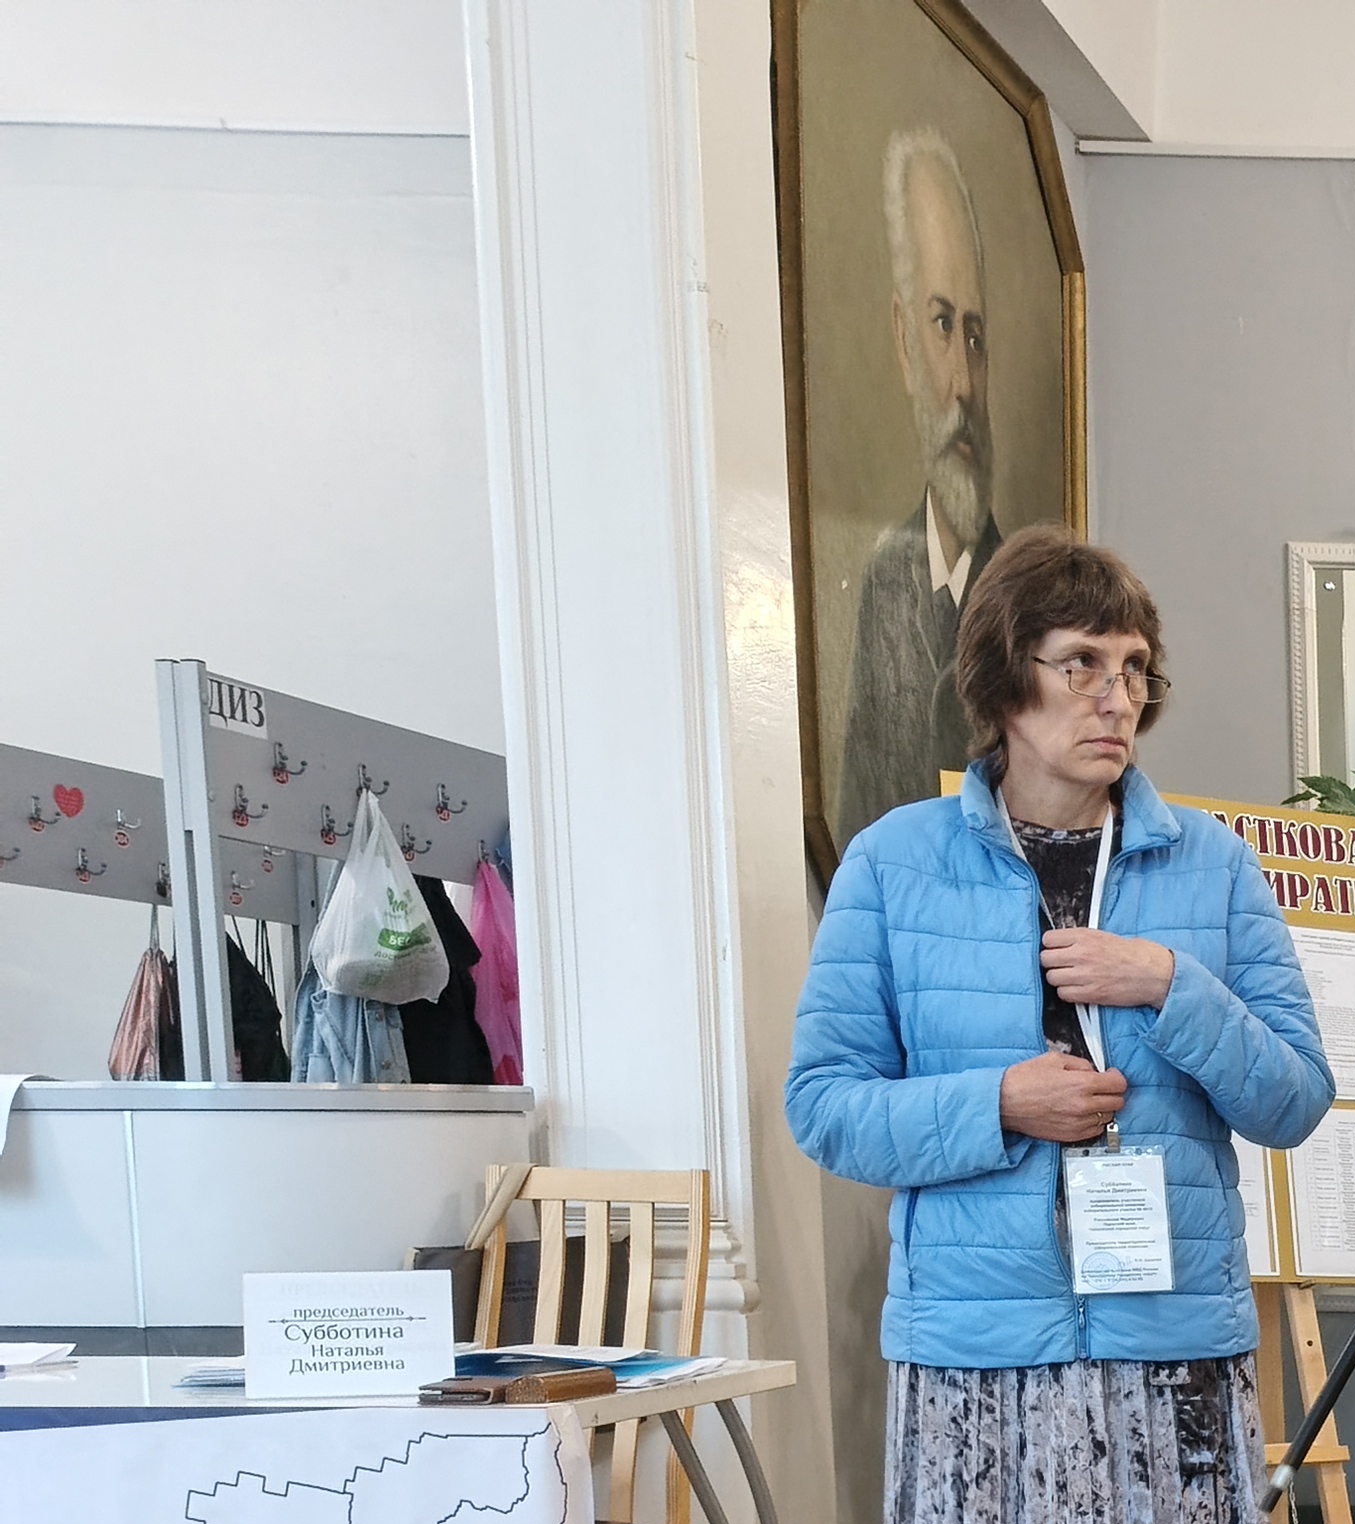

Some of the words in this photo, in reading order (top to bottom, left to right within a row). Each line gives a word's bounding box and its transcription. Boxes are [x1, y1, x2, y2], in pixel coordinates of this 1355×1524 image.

[293, 1306, 404, 1320] председатель
[284, 1324, 404, 1344] Субботина
[312, 1344, 384, 1358] Наталья
[289, 1358, 406, 1375] Дмитриевна
